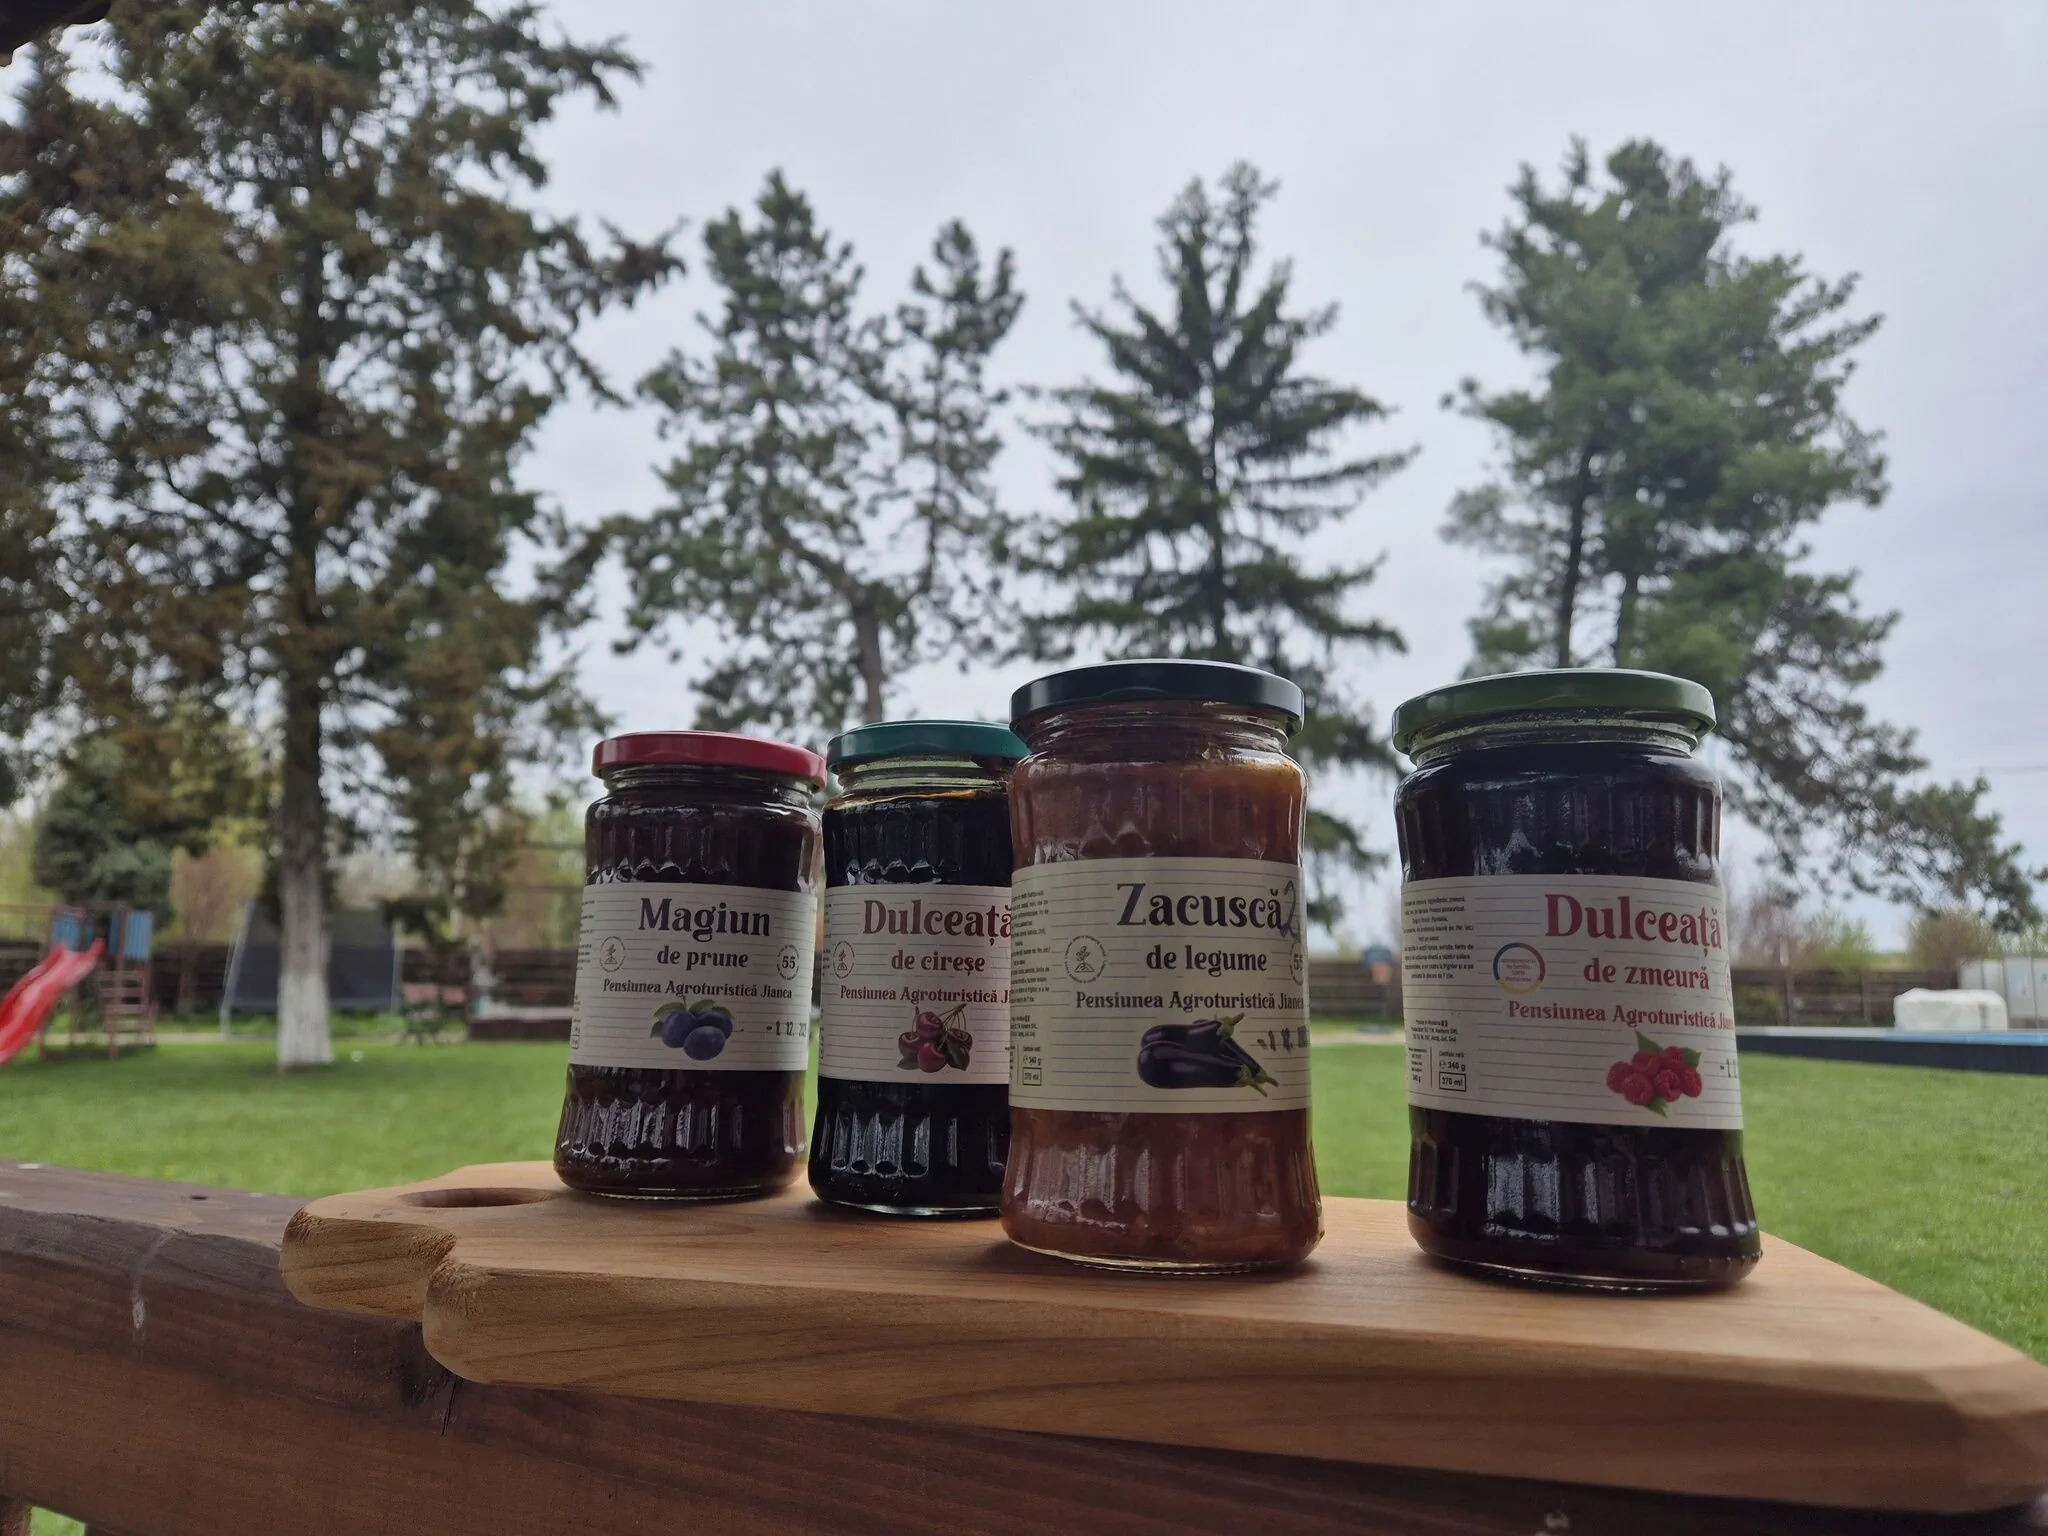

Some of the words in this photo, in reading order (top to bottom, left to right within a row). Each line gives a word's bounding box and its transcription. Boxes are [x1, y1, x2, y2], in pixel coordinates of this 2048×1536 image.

[1116, 882, 1281, 929] Zacuscă
[638, 897, 770, 943] Magiun
[1544, 893, 1723, 958] Dulceață
[656, 945, 681, 965] de
[687, 951, 749, 971] prune
[781, 955, 796, 969] 55
[891, 949, 915, 970] de
[920, 951, 985, 976] cireșe
[1146, 944, 1176, 970] de
[1185, 944, 1267, 977] legume
[1583, 957, 1616, 983] de
[1625, 965, 1710, 990] zmeură
[602, 977, 661, 993] Pensiunea
[664, 980, 758, 998] Agroturistică
[760, 984, 792, 999] Jianca
[840, 984, 896, 1001] Pensiunea
[900, 986, 998, 1005] Agroturistică
[1075, 990, 1164, 1009] Pensiunea
[1168, 990, 1275, 1013] Agroturistică
[1508, 1000, 1606, 1022] Pensiunea
[1612, 1004, 1716, 1029] Agroturistică
